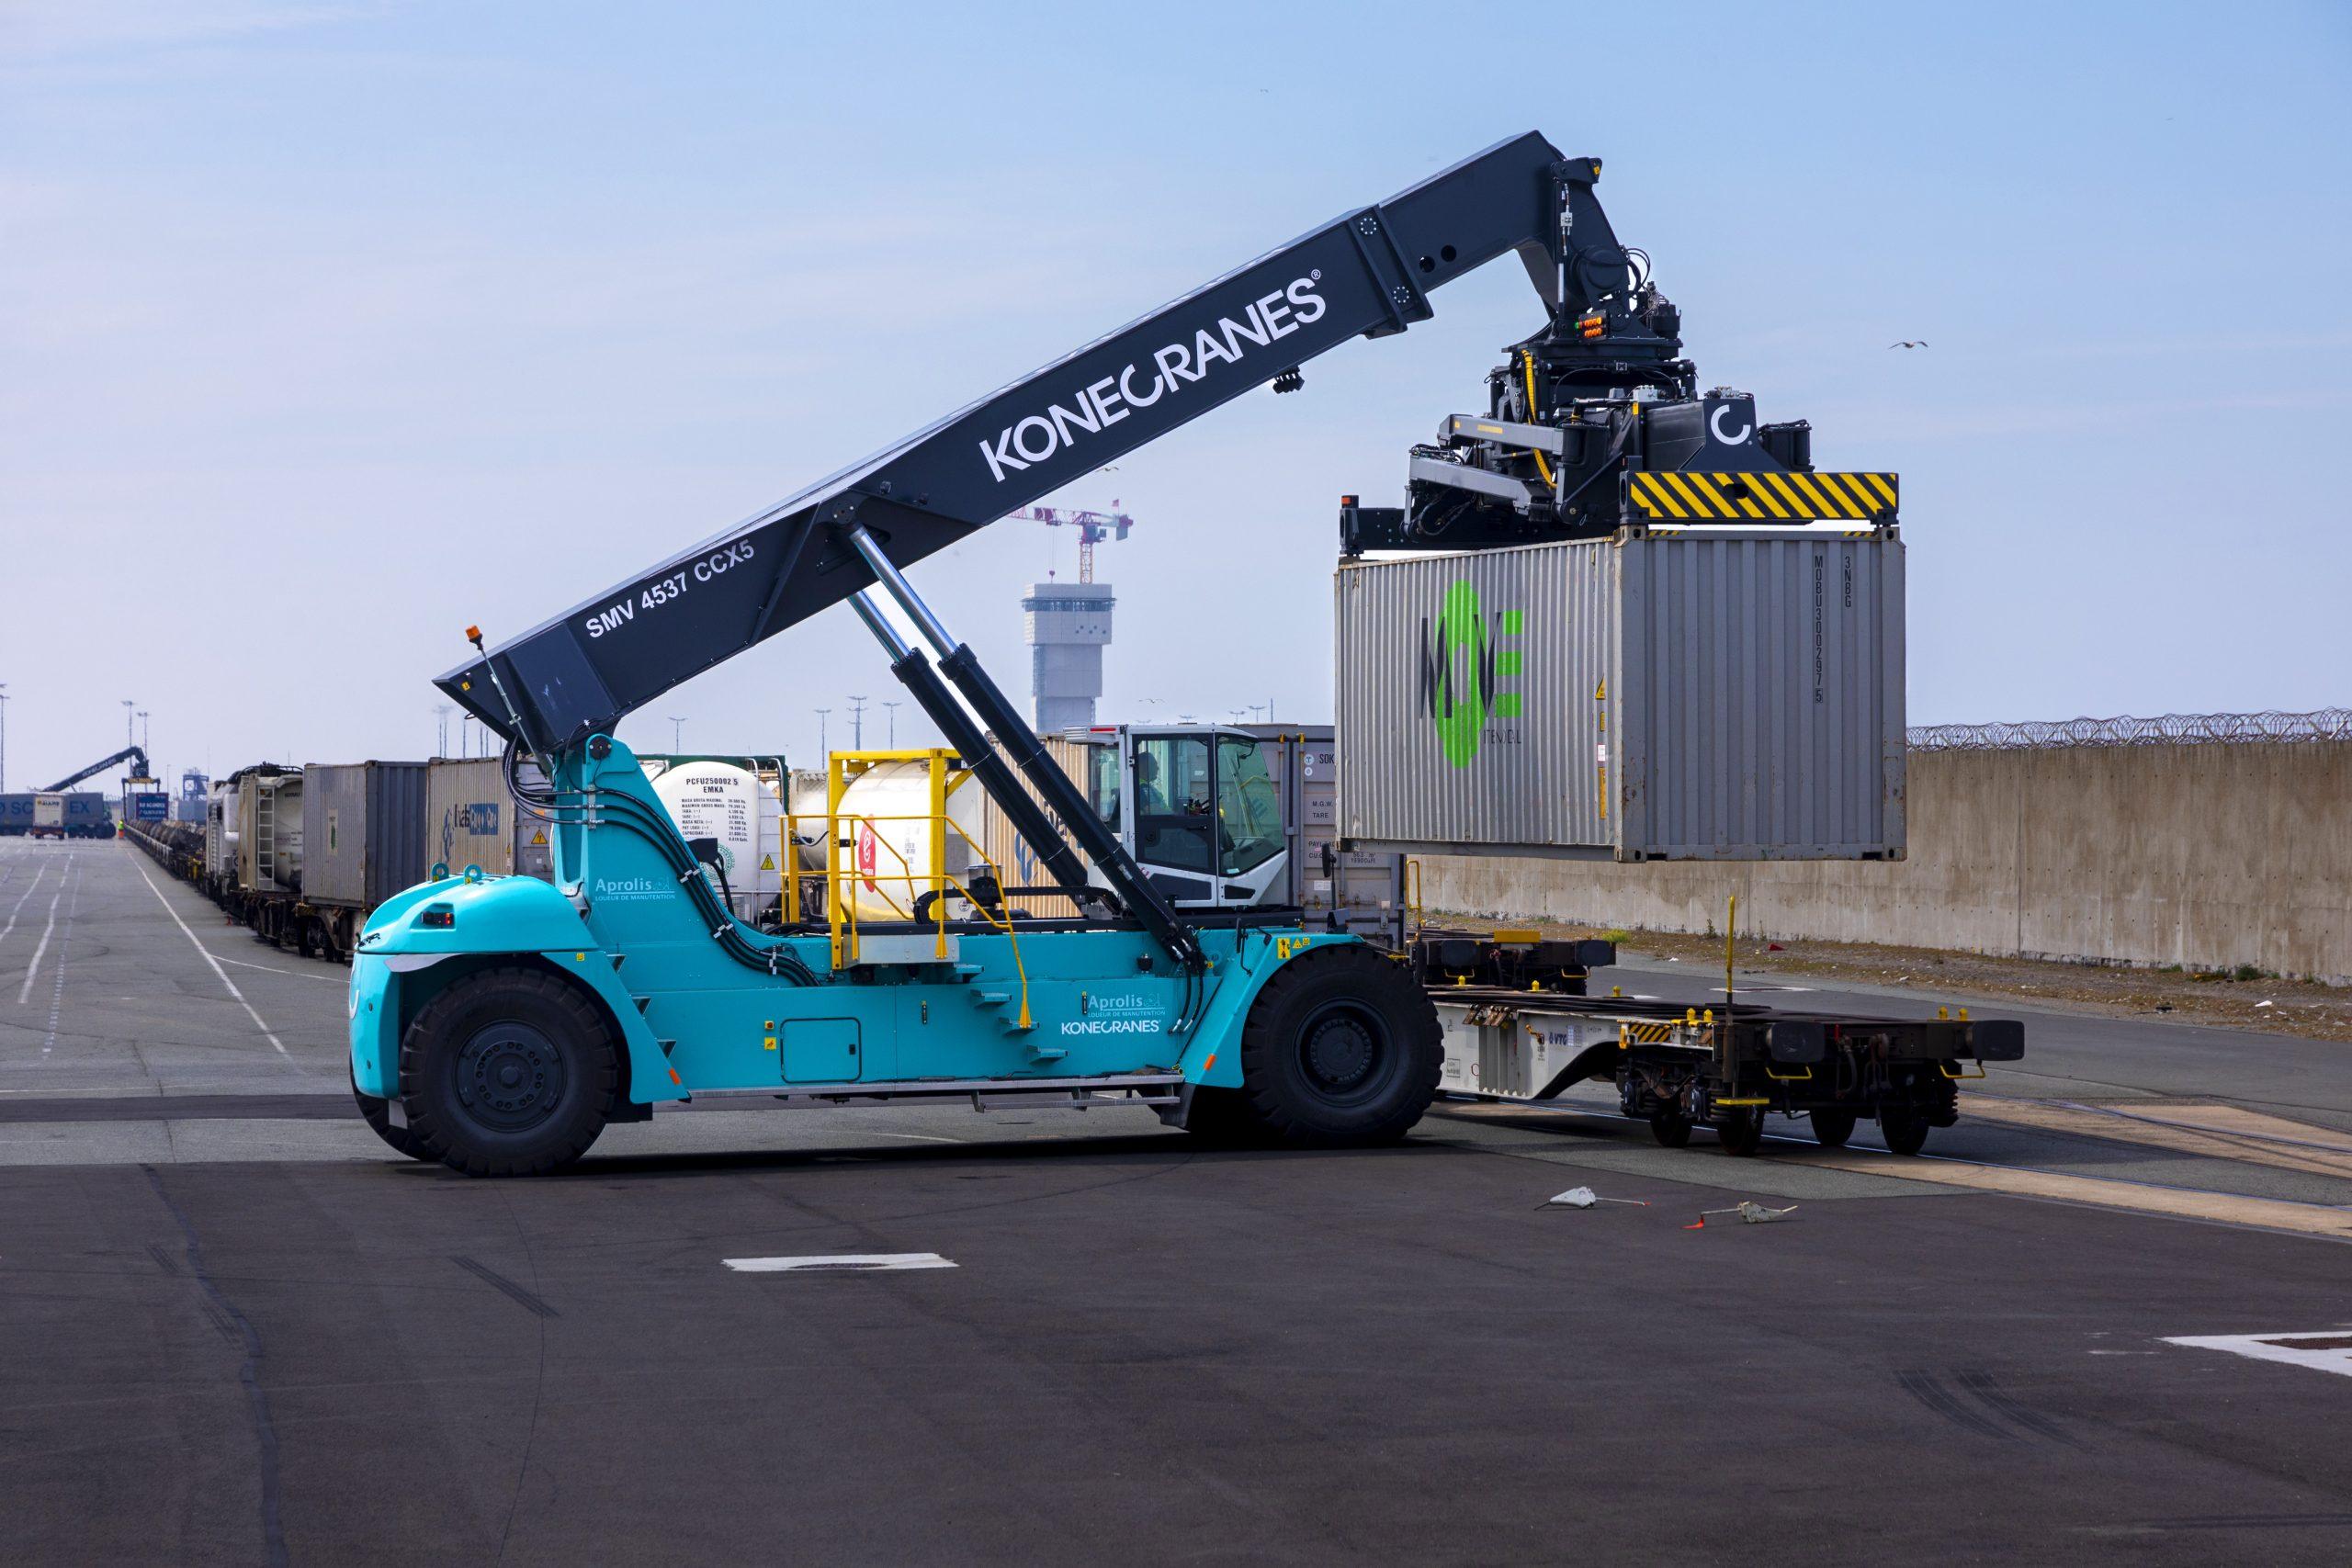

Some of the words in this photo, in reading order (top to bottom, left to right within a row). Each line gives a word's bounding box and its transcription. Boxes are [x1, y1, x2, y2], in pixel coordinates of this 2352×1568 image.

[978, 276, 1327, 483] KONECRANES
[585, 599, 634, 638] SMV
[640, 571, 688, 610] 4537
[694, 538, 754, 582] CCX5
[595, 877, 652, 895] Aprolis
[1088, 994, 1143, 1011] Aprolis
[1060, 1019, 1160, 1035] KONECRANES
